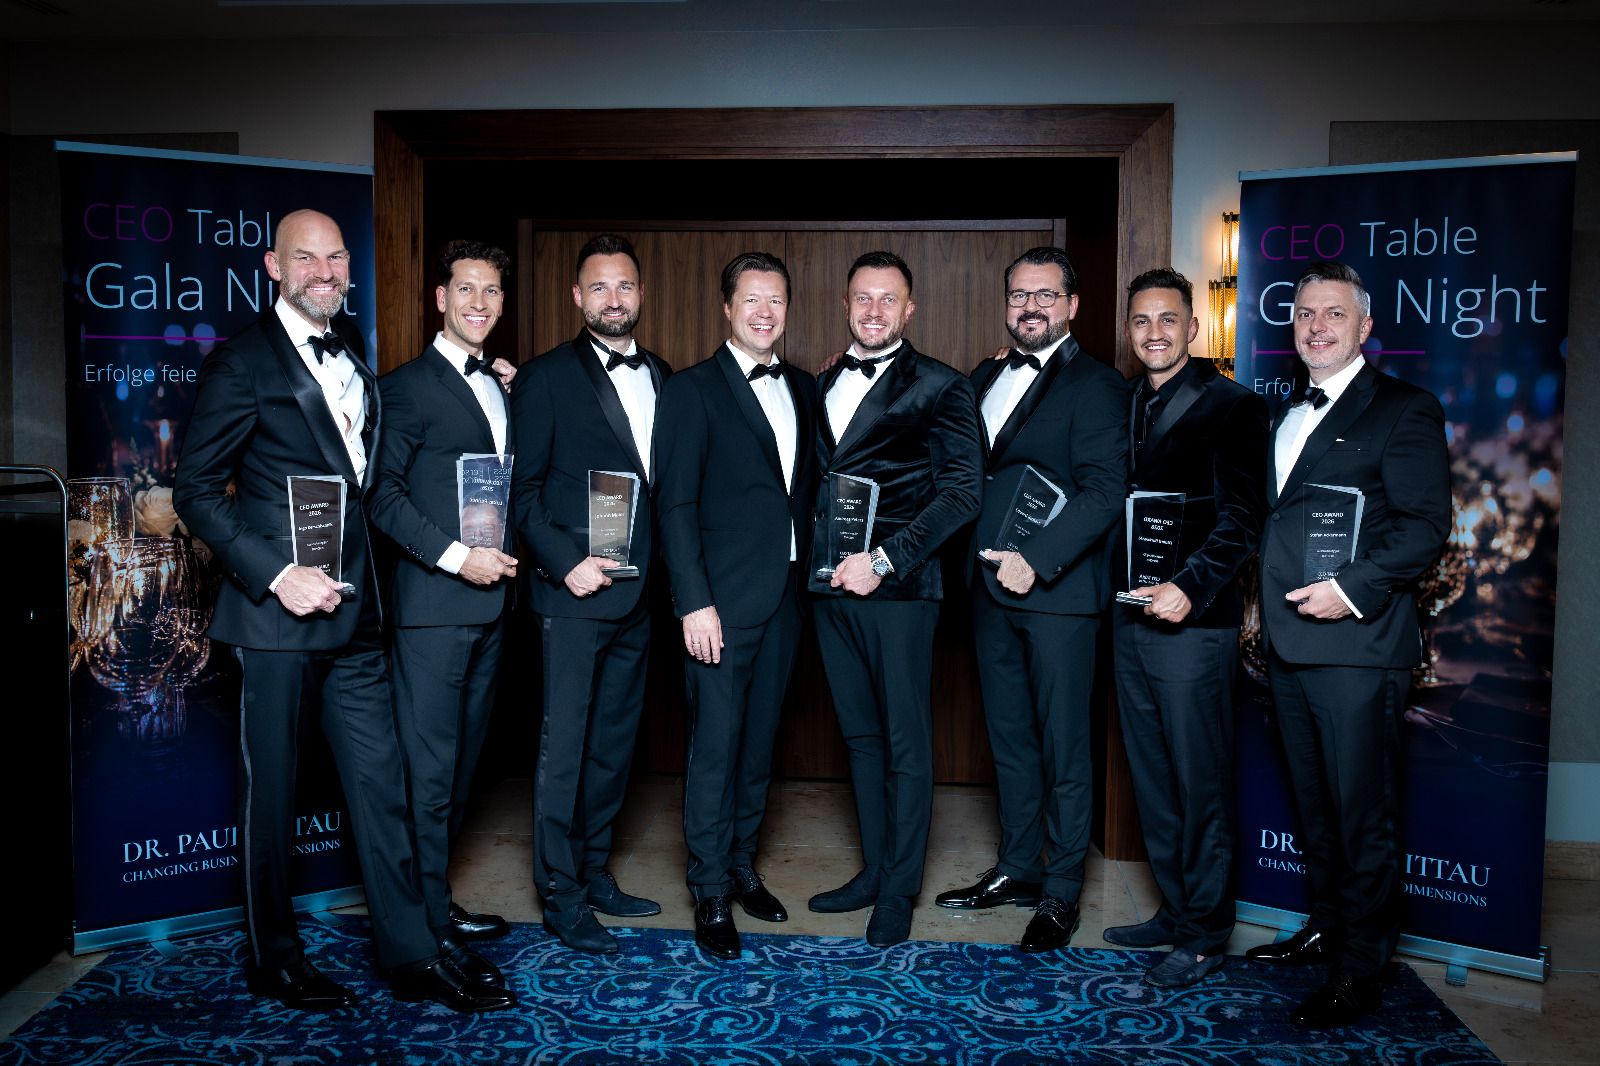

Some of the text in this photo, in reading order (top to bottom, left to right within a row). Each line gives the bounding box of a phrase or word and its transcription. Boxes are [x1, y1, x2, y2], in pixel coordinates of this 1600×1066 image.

[83, 202, 272, 249] CEO Tabl
[1260, 216, 1478, 262] CEO Table
[85, 262, 204, 312] Gala
[1396, 274, 1548, 339] Night
[84, 363, 198, 387] Erfolge feie
[122, 838, 170, 864] DR.
[122, 861, 200, 883] CHANGING
[1258, 857, 1307, 875] CHANG
[1259, 828, 1492, 887] DR. ITTAU
